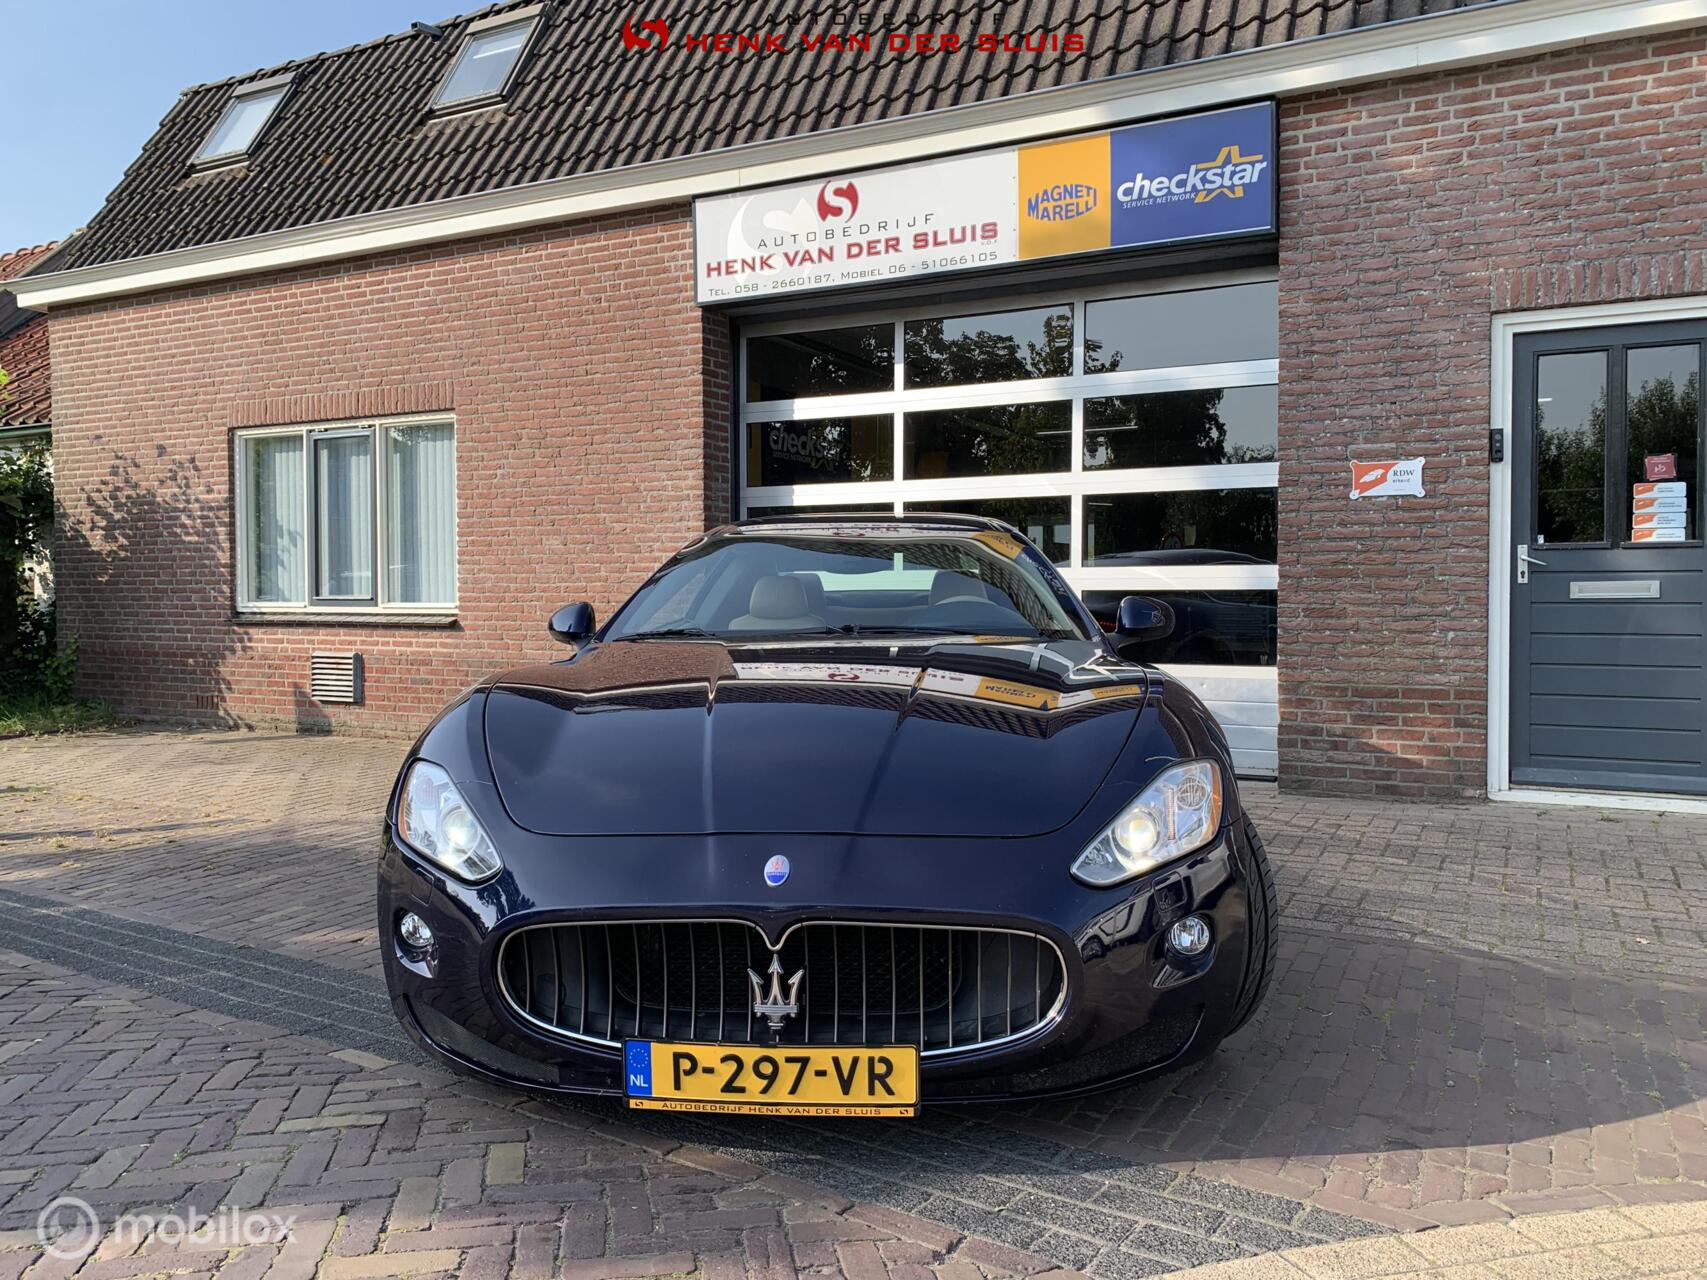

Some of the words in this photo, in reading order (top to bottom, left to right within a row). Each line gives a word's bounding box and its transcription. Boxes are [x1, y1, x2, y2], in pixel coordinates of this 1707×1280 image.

[1117, 161, 1268, 202] checkstar
[1028, 184, 1097, 213] MAGNETI
[1028, 194, 1097, 221] MARELLI
[1122, 198, 1154, 209] SERVICE
[1157, 192, 1196, 204] NETWORK
[757, 213, 935, 249] AUTOBEDRIJF
[706, 252, 777, 278] HENK
[783, 245, 834, 267] VAN
[846, 236, 902, 260] DER
[912, 221, 998, 250] SLUIS
[734, 283, 759, 294] 058
[772, 273, 835, 290] 2660187,
[888, 263, 906, 274] 06
[921, 251, 998, 270] 51066105
[1393, 469, 1415, 477] RDW
[630, 1074, 648, 1087] NL
[672, 1052, 896, 1096] P-297-VR
[661, 1102, 745, 1112] AUTOBEDRIJF
[748, 1103, 782, 1113] HENK
